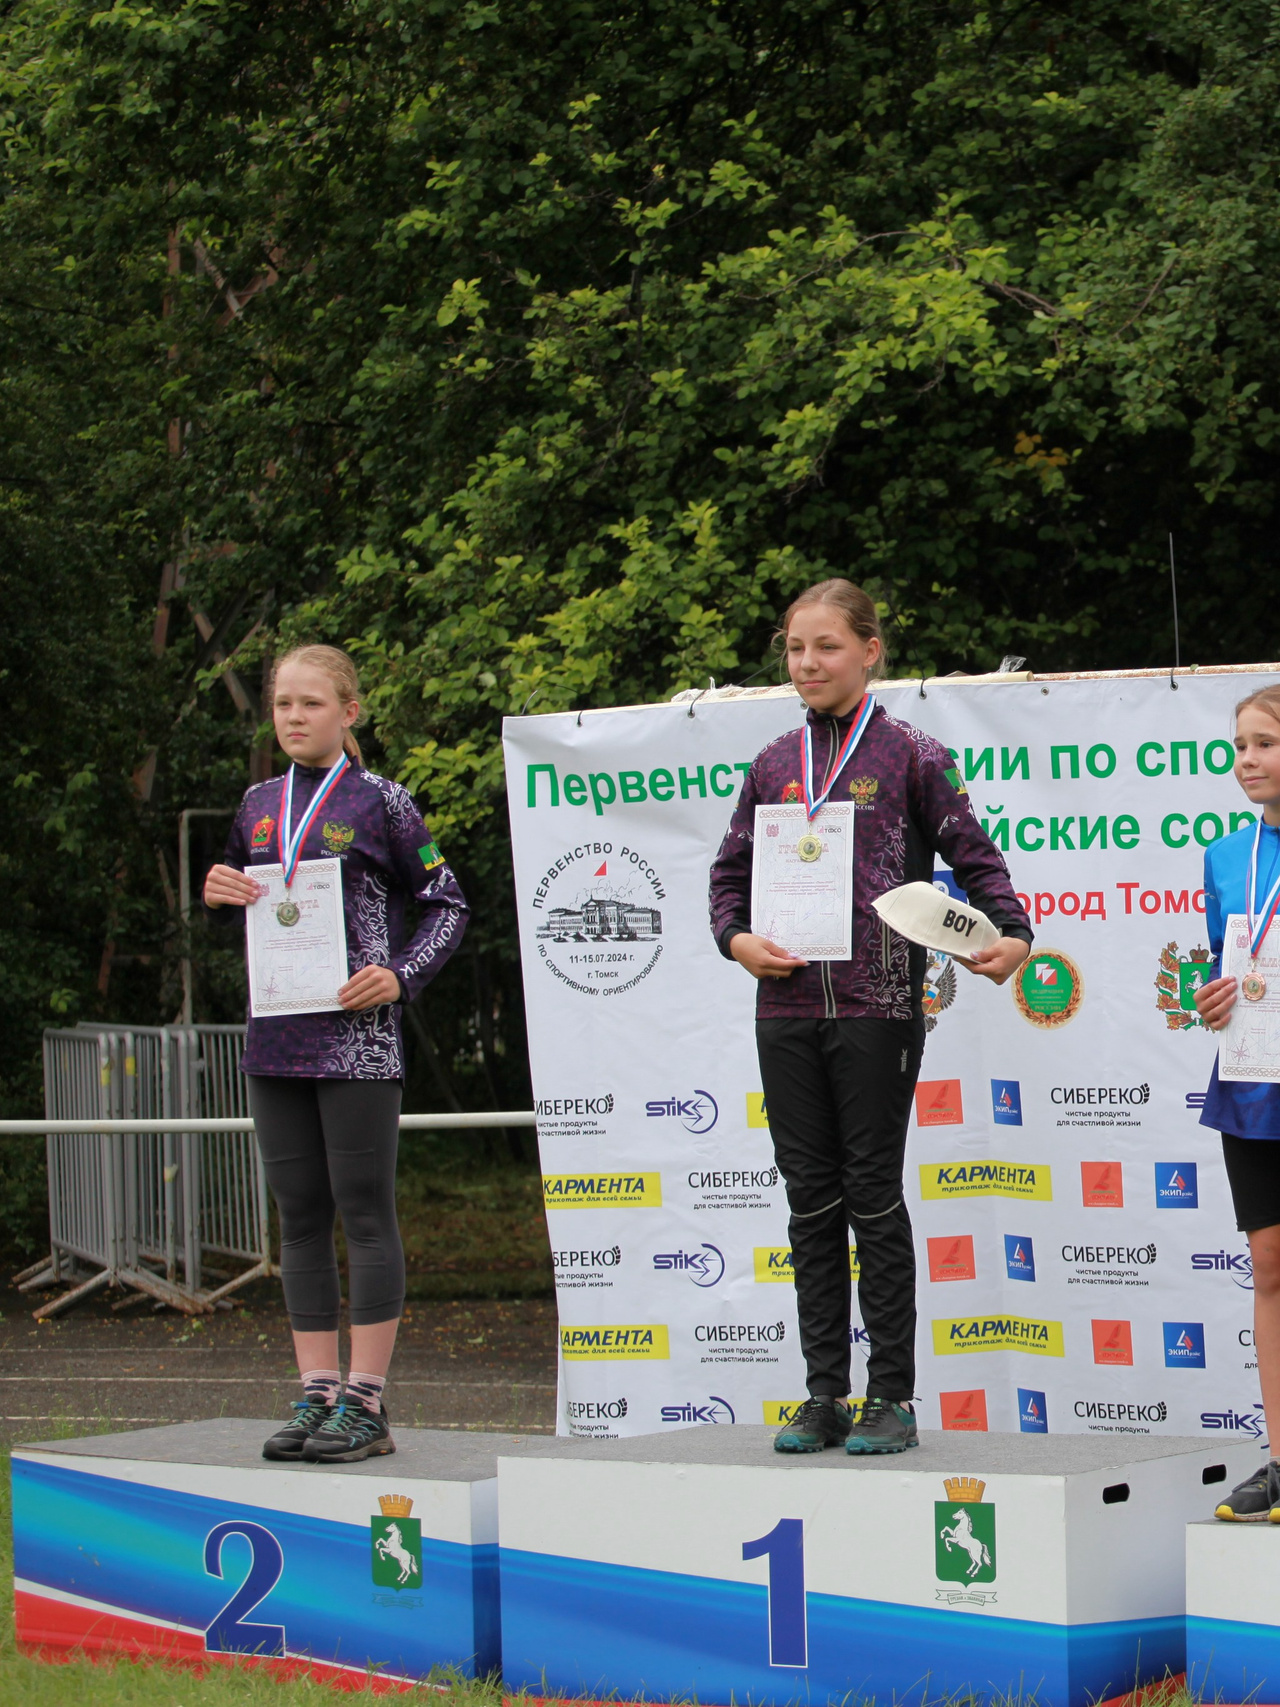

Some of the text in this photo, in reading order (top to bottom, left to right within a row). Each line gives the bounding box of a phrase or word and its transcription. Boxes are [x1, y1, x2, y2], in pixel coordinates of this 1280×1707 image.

[1051, 743, 1117, 779] по
[532, 842, 667, 909] ПЕРВЕНСТВО РОССИИ
[1116, 882, 1207, 915] Томс
[943, 909, 977, 937] BOY
[537, 944, 664, 996] ПО СПОРТИВНОМУ ОРИЕНТИРОВАНИЮ
[595, 970, 619, 979] Томск
[1051, 1086, 1143, 1105] СИБЕРЕКО
[1056, 1118, 1141, 1127] для счастливой жизни
[1094, 1110, 1131, 1118] продукты
[560, 1120, 598, 1129] продукты
[688, 1170, 773, 1189] СИБЕРЕКО
[937, 1165, 1036, 1185] КАРМЕНТА
[543, 1177, 645, 1195] КАРМЕНТА
[942, 1183, 991, 1194] трикотаж
[708, 1202, 747, 1210] счастливой
[729, 1193, 762, 1202] продукты
[1061, 1245, 1150, 1265] СИБЕРЕКО
[566, 1272, 604, 1280] продукты
[1067, 1277, 1081, 1285] для
[1082, 1277, 1123, 1286] счастливой
[1103, 1269, 1139, 1277] продукты
[694, 1324, 779, 1342] СИБЕРЕКО
[950, 1320, 1049, 1341] КАРМЕНТА
[735, 1346, 769, 1355] продукты
[954, 1338, 1003, 1348] трикотаж
[700, 1356, 714, 1364] для
[715, 1355, 754, 1363] счастливой
[1074, 1401, 1161, 1422] СИБЕРЕКО
[1088, 1424, 1150, 1434] чистые продукты
[205, 1521, 286, 1658] 2
[741, 1518, 808, 1668] 1
